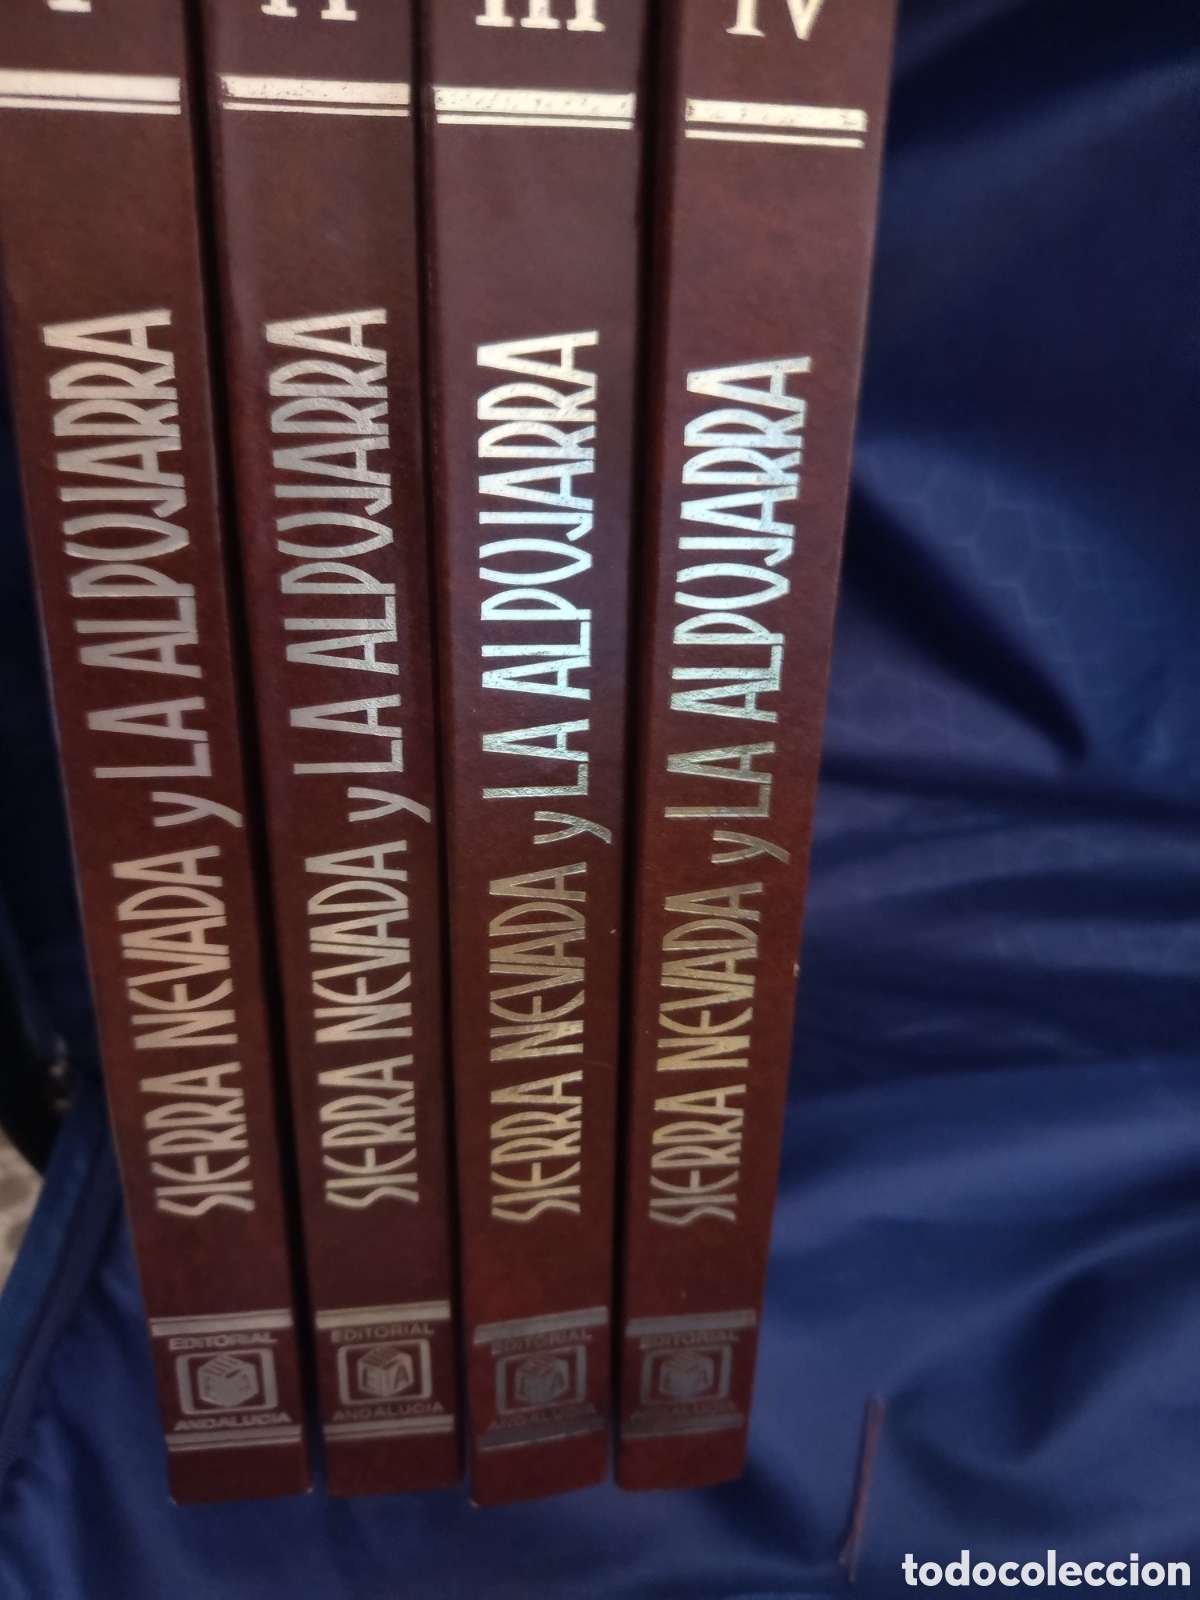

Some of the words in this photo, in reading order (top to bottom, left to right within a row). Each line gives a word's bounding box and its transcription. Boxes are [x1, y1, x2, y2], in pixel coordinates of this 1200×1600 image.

[43, 309, 202, 678] ALPUJARRA
[265, 308, 399, 675] ALPUJARRA
[477, 331, 598, 700] ALPUJARRA
[670, 356, 811, 723] ALPUJARRA
[88, 697, 211, 778] LA
[290, 694, 403, 774] LA
[347, 787, 431, 823] y
[482, 718, 590, 798] LA
[664, 741, 776, 819] LA
[151, 791, 242, 828] y
[533, 811, 612, 845] y
[710, 830, 790, 864] y
[113, 845, 238, 1049] NEVADA
[305, 839, 413, 1044] NEVADA
[489, 862, 587, 1061] NEVADA
[656, 882, 763, 1071] NEVADA
[140, 1061, 255, 1216] SIERRA
[318, 1054, 419, 1209] SIERRA
[490, 1070, 583, 1220] SIERRA
[648, 1084, 747, 1227] SIERRA
[169, 1331, 278, 1350] EDITORIAL
[331, 1323, 434, 1343] EDITORIAL
[332, 1401, 444, 1421] ANDALUCIA
